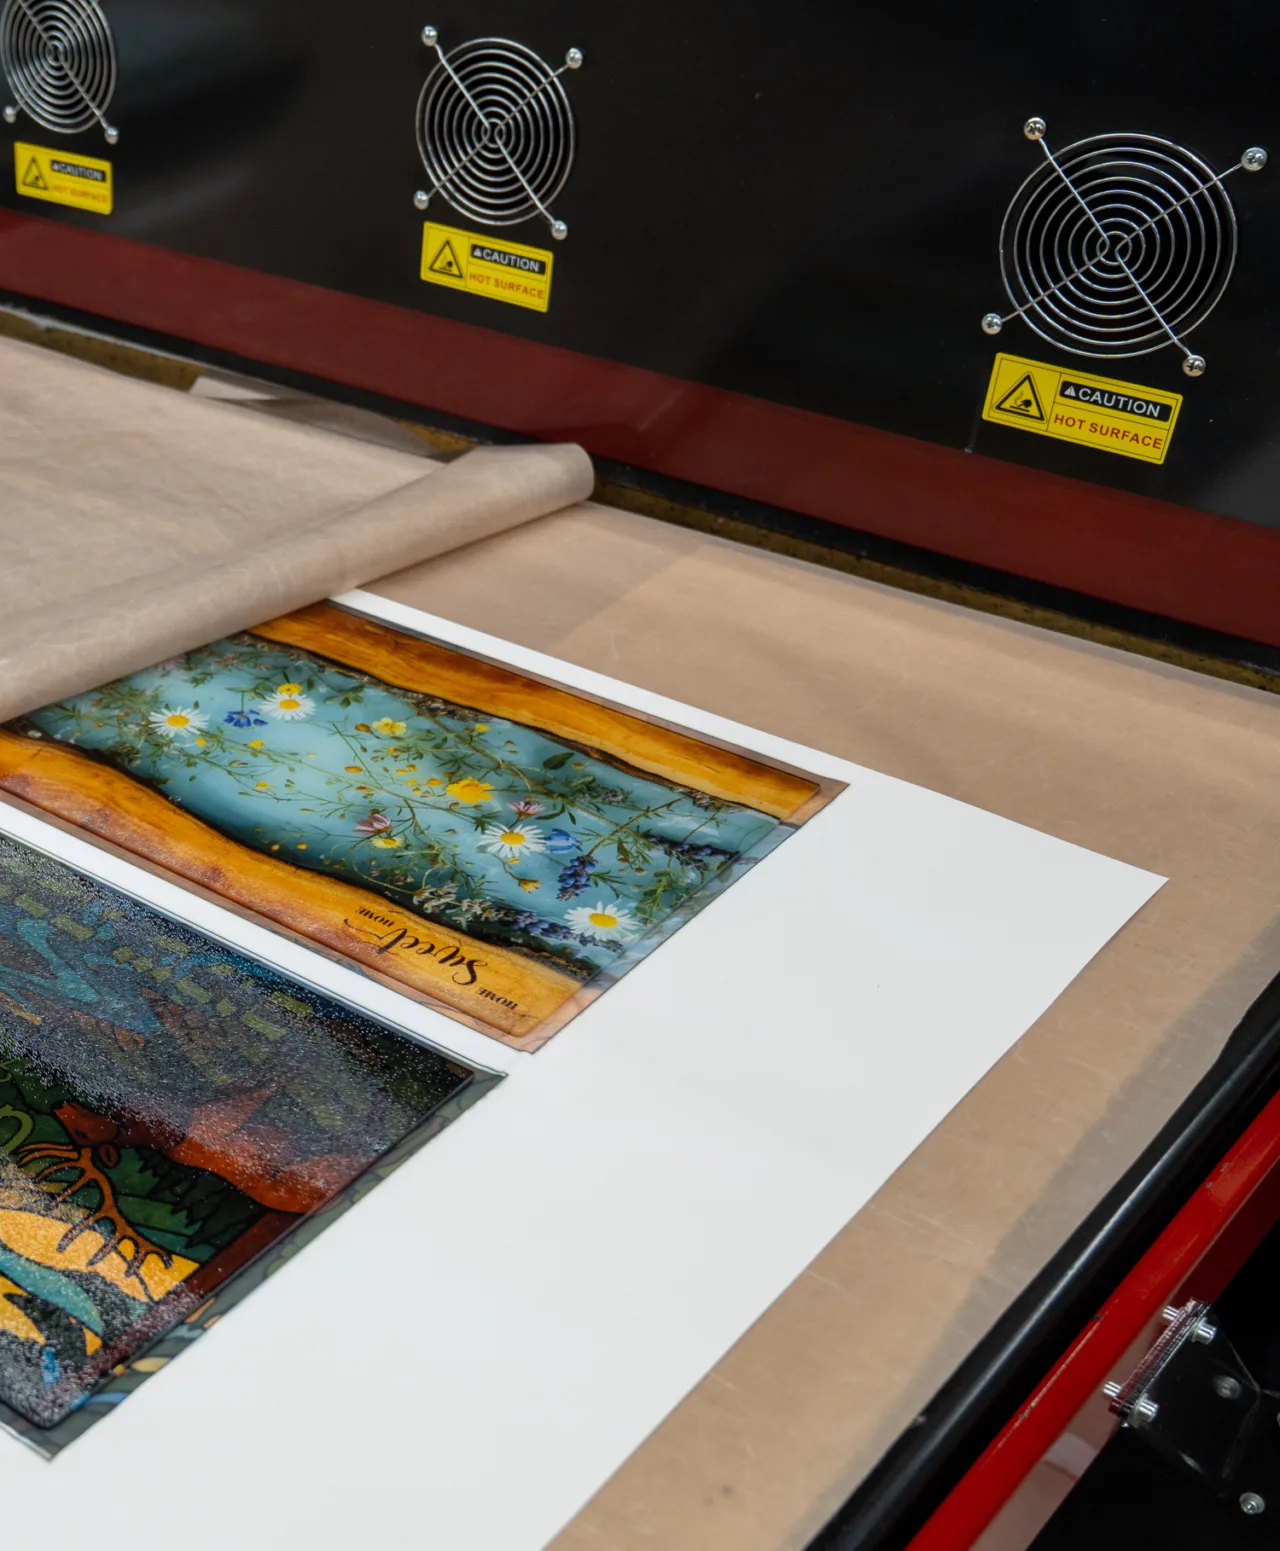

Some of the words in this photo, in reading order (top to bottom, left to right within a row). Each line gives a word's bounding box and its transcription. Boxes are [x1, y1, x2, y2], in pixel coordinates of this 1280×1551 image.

[58, 163, 103, 181] CAUTION
[482, 248, 540, 273] CAUTION
[469, 272, 491, 286] HOT
[493, 278, 545, 299] SURFACE
[1078, 388, 1160, 418] CAUTION
[1054, 413, 1086, 430] HOT
[1088, 422, 1163, 450] SURFACE
[356, 906, 395, 928] HOME
[343, 918, 488, 986] Sweet
[476, 987, 518, 1011] HOME
